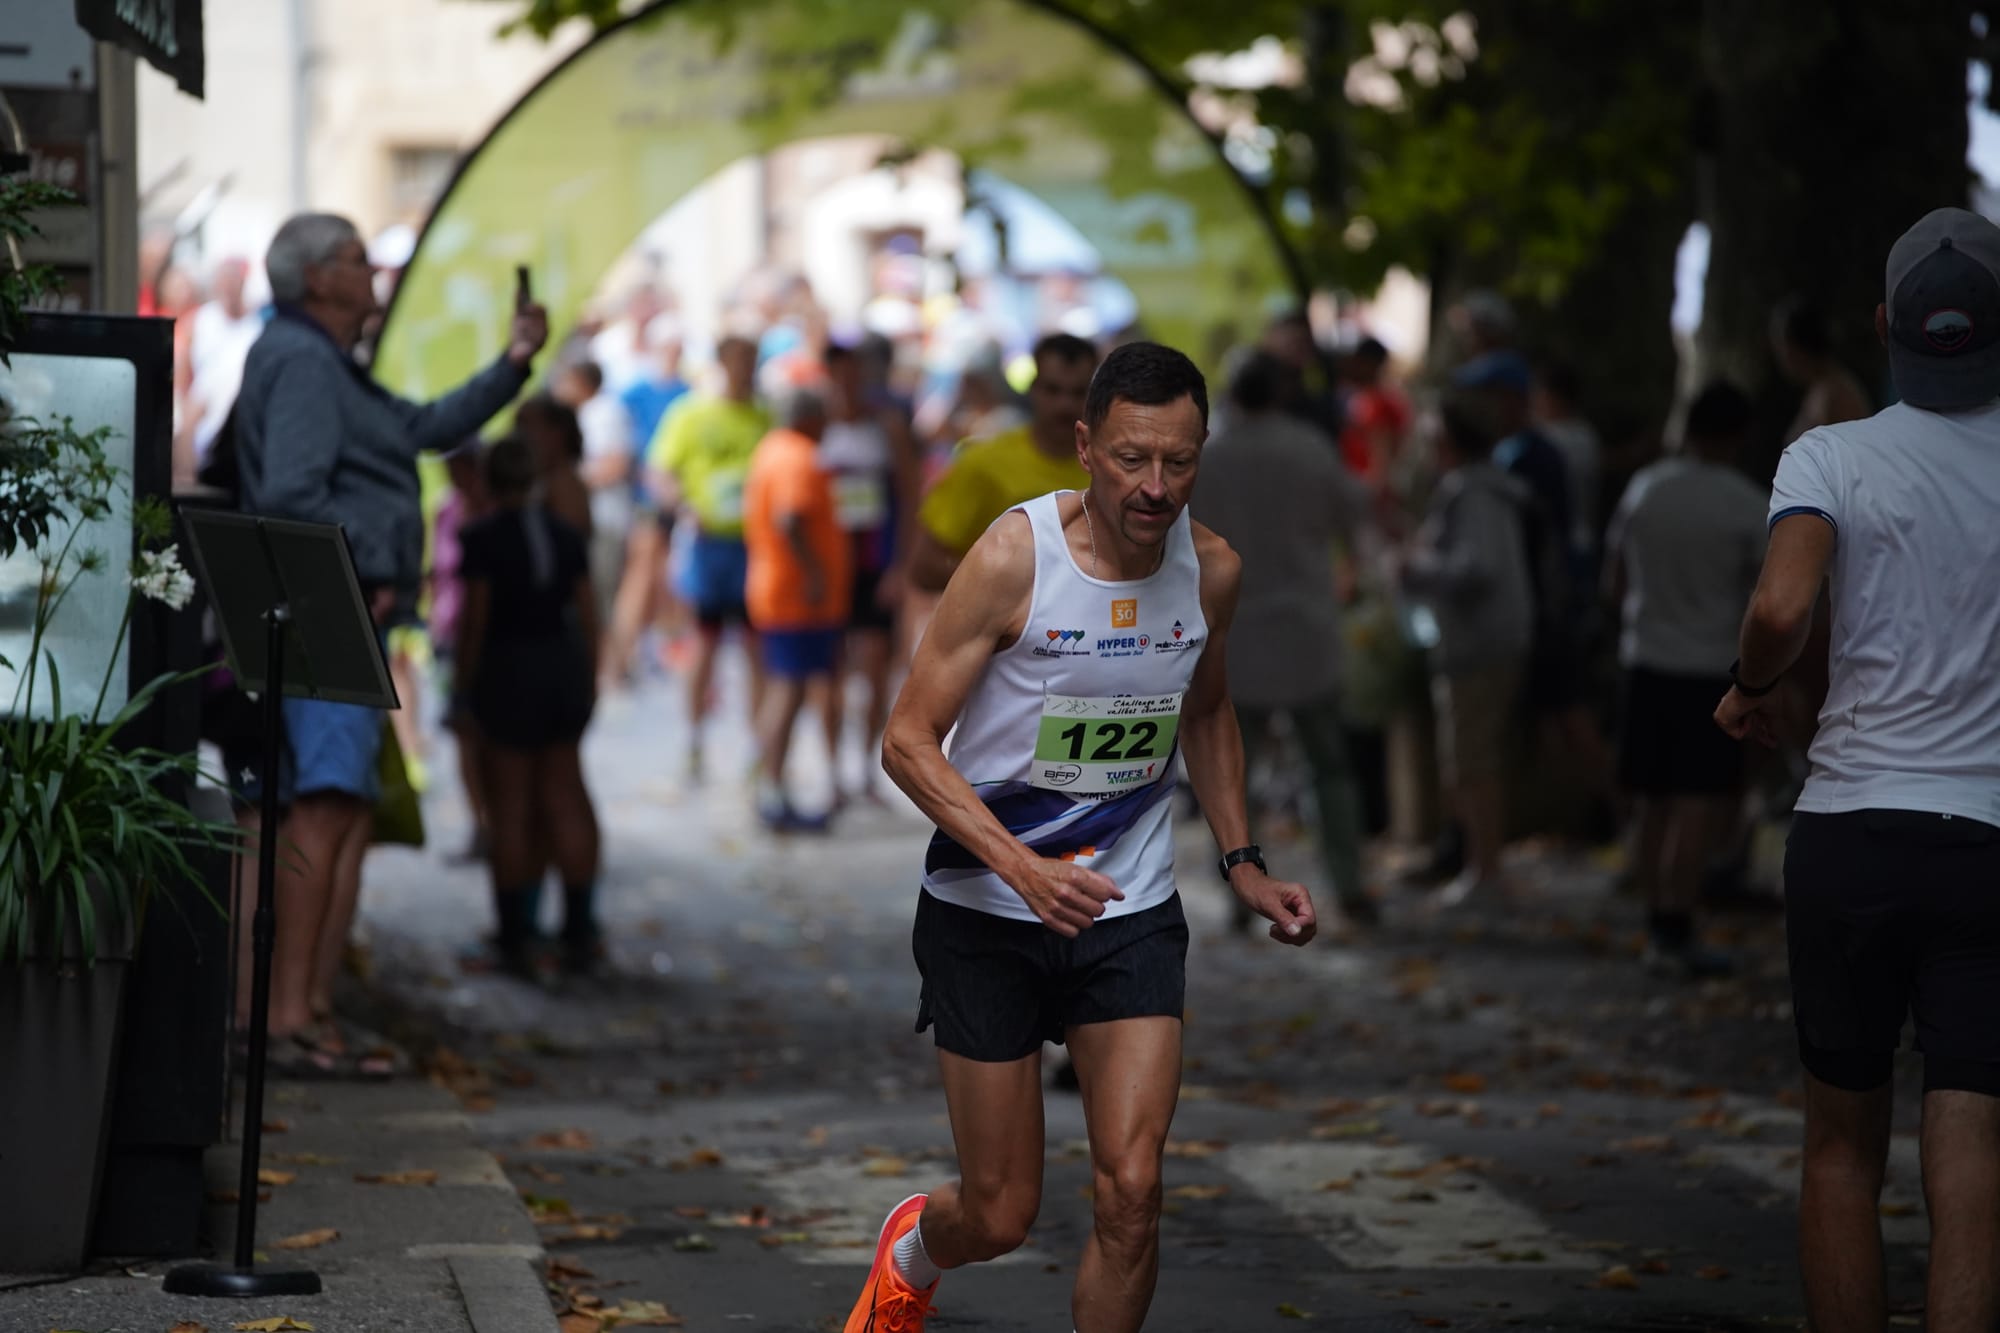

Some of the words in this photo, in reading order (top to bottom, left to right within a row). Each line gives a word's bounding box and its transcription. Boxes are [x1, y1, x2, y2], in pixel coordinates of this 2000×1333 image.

[1115, 608, 1134, 621] 30
[1097, 637, 1135, 650] HYPER
[1113, 699, 1155, 708] Challenge
[1060, 721, 1159, 761] 122
[1044, 770, 1076, 780] BFP
[1106, 768, 1144, 779] TUFF'S
